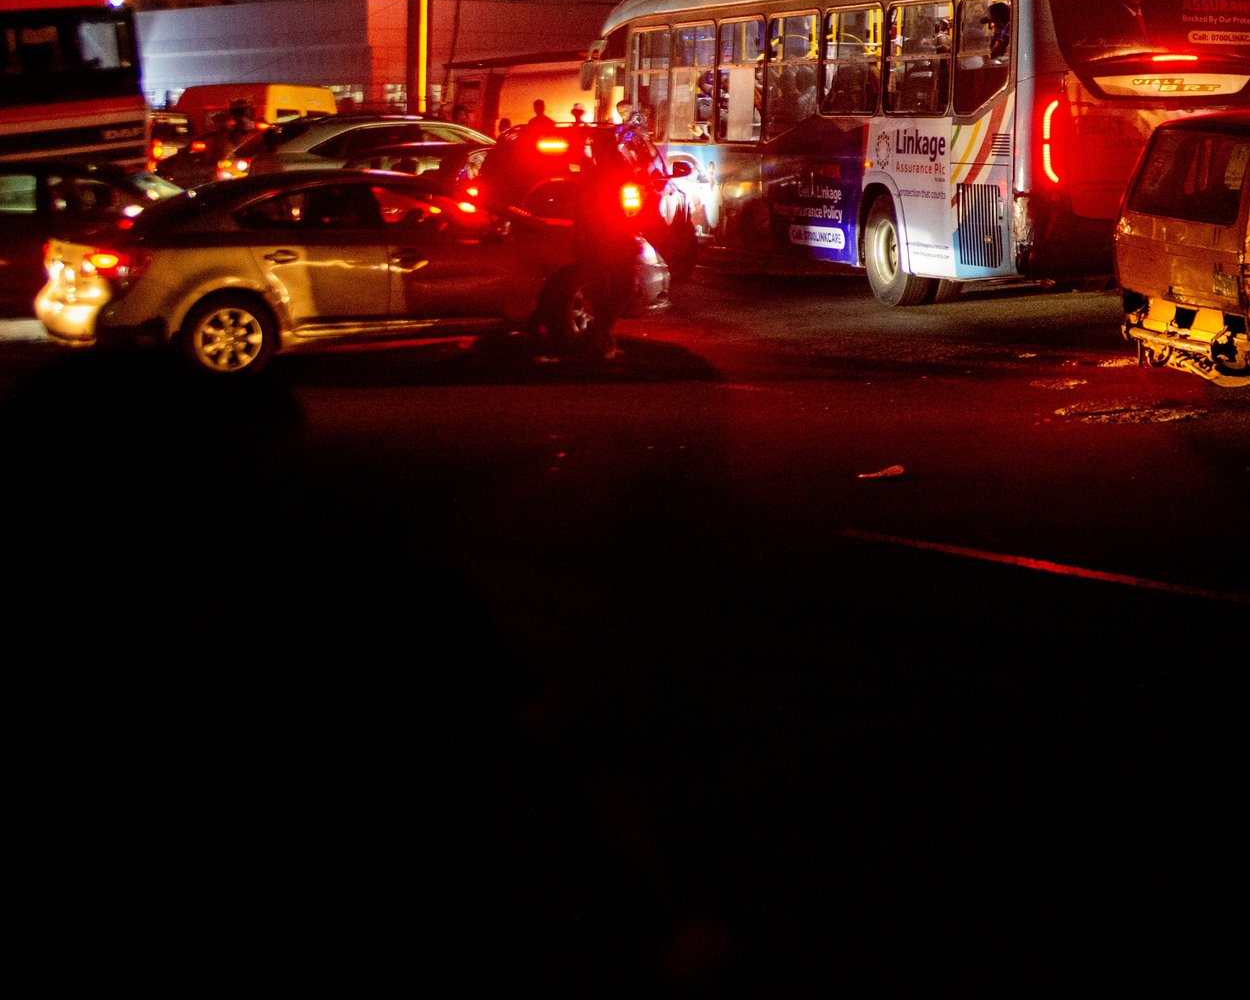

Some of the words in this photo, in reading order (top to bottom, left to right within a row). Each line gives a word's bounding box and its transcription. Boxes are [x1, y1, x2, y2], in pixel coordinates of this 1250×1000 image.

[1182, 14, 1208, 23] Backed
[1208, 15, 1218, 24] By
[1218, 15, 1232, 24] Our
[1132, 78, 1184, 86] VIALE
[1158, 84, 1221, 92] BRT
[895, 128, 946, 162] Linkage
[895, 161, 933, 175] Assurance
[934, 162, 946, 175] Plc
[817, 184, 842, 203] Linkage
[823, 204, 843, 224] Policy
